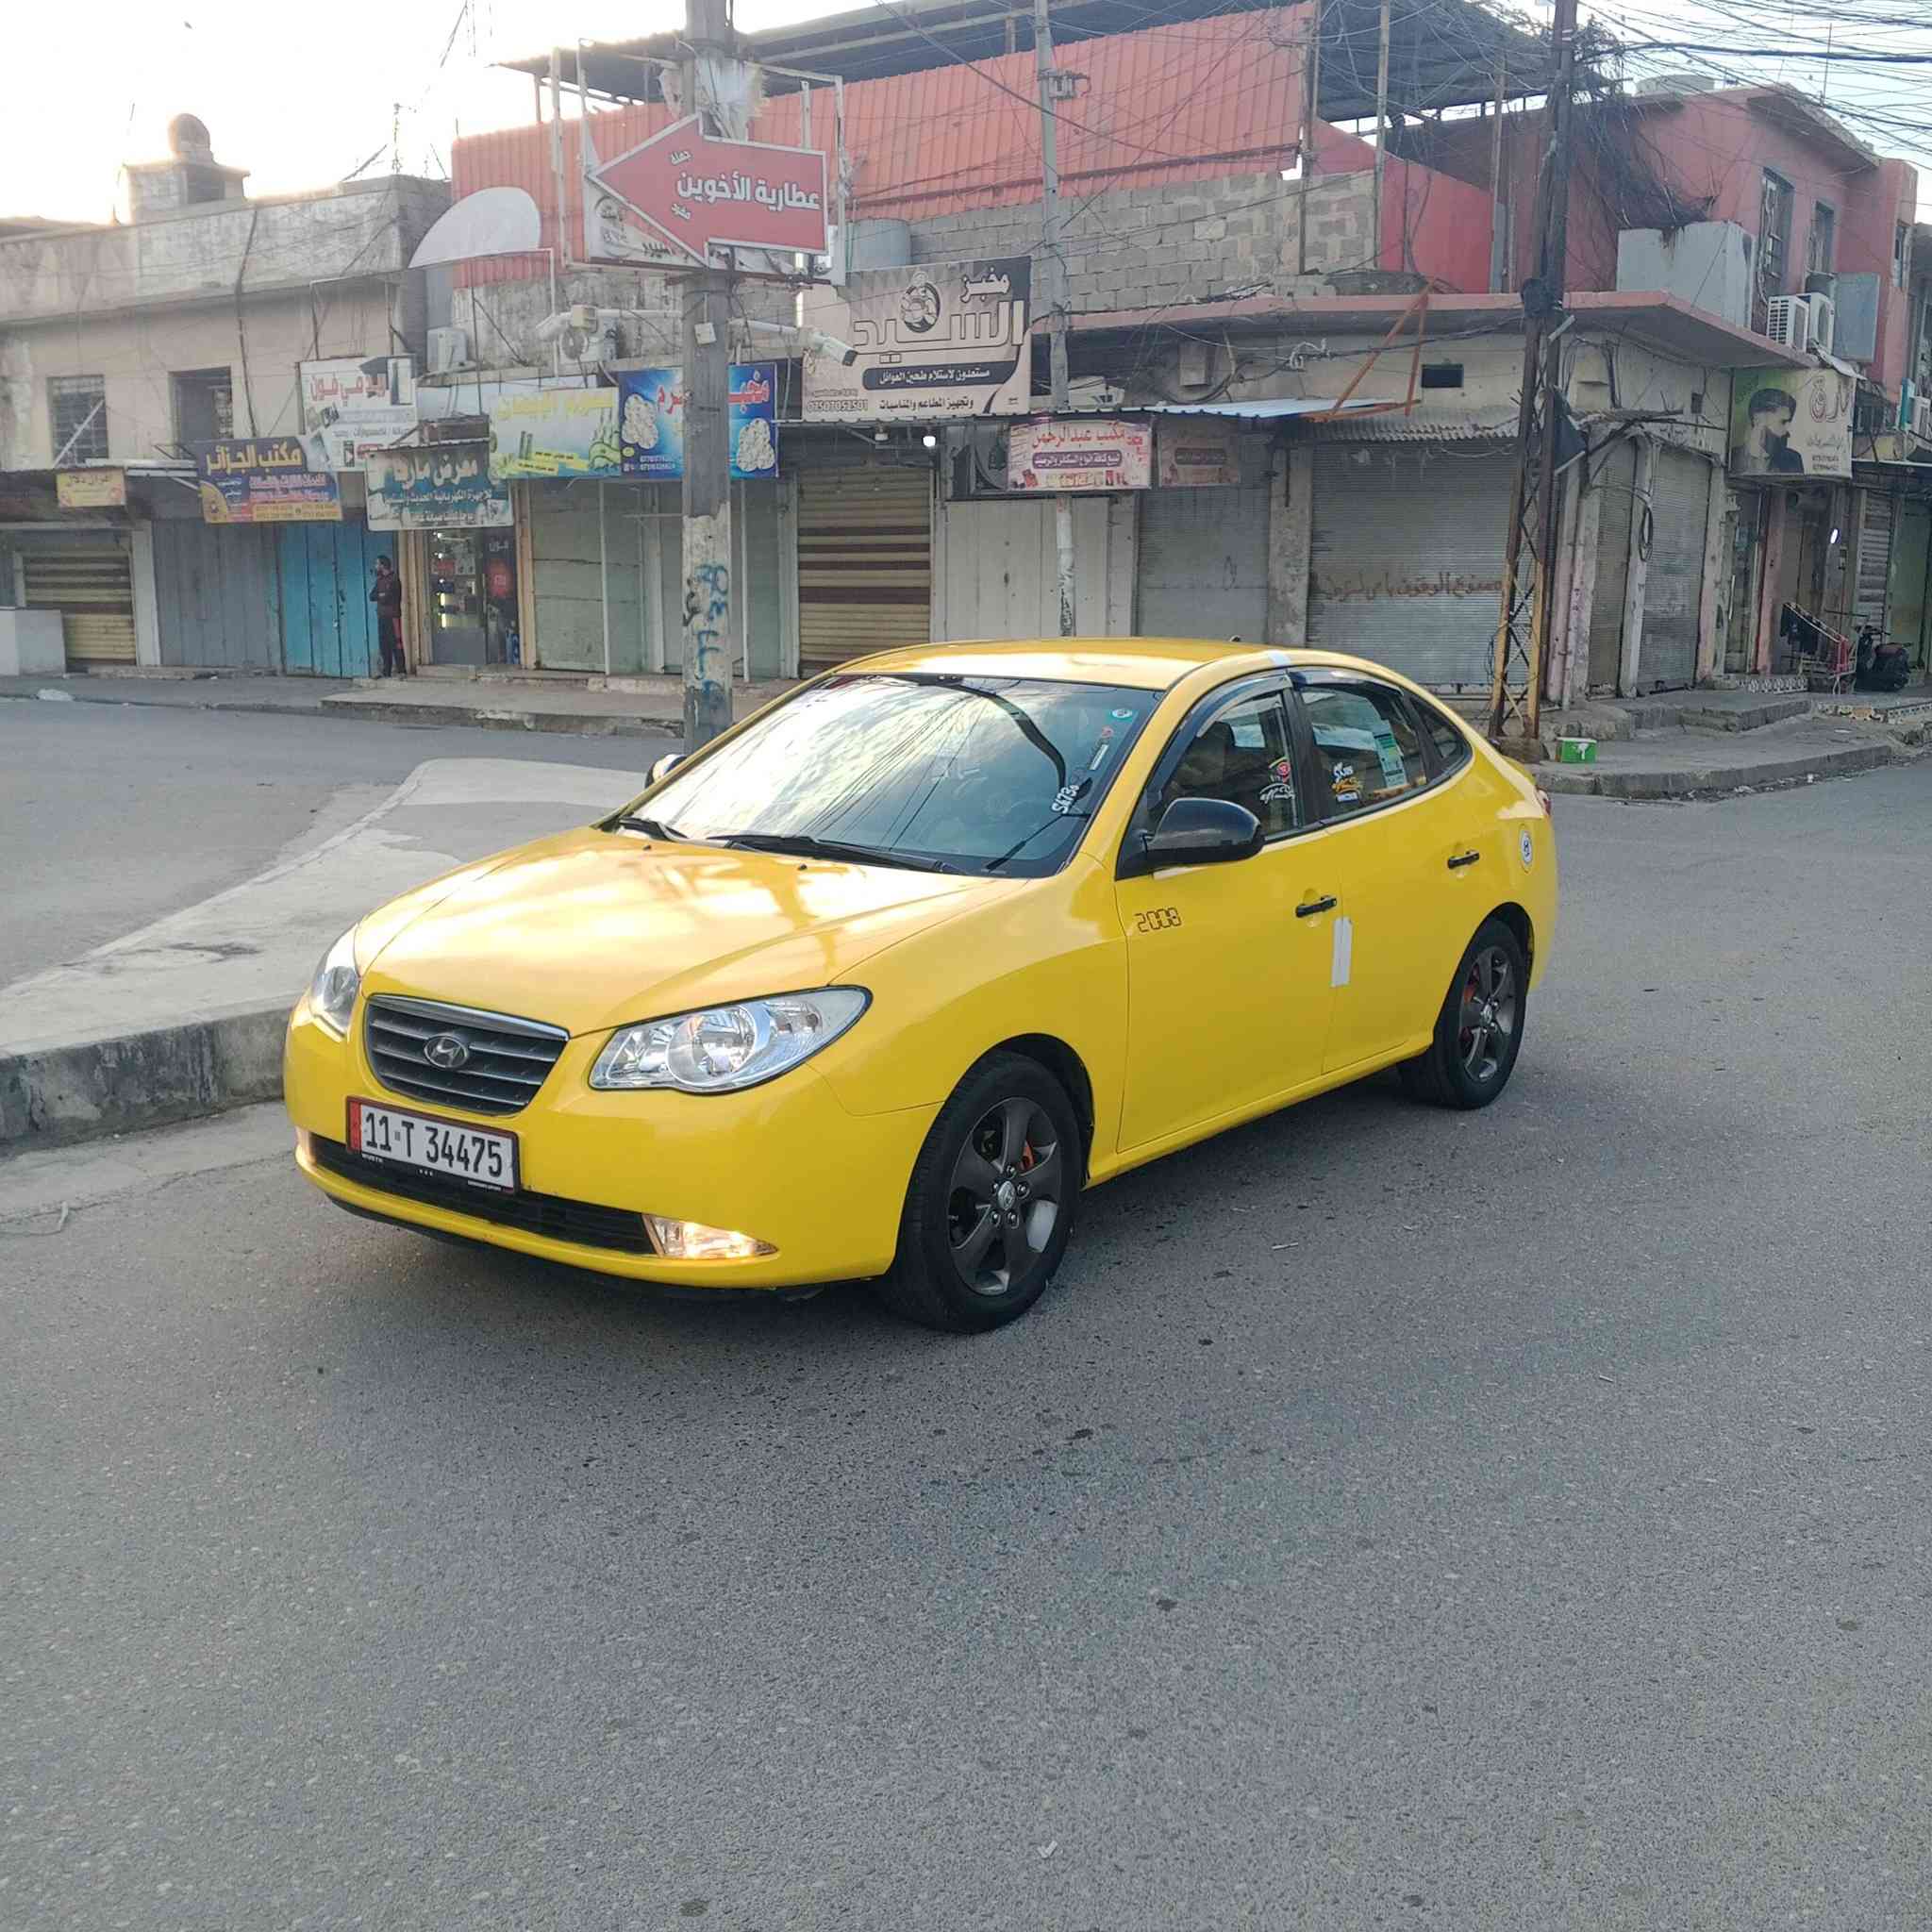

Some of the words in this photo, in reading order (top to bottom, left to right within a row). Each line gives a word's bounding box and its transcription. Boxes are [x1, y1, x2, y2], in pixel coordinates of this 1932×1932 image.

[677, 171, 751, 204] الأخوين
[757, 179, 821, 211] عطارية
[959, 266, 1011, 303] مخبز
[853, 300, 1025, 364] السيد
[206, 444, 258, 476] الجزائر
[258, 441, 303, 474] مكتب
[366, 1112, 392, 1153] 11
[401, 1121, 415, 1158] T
[425, 1126, 503, 1178] 34475
